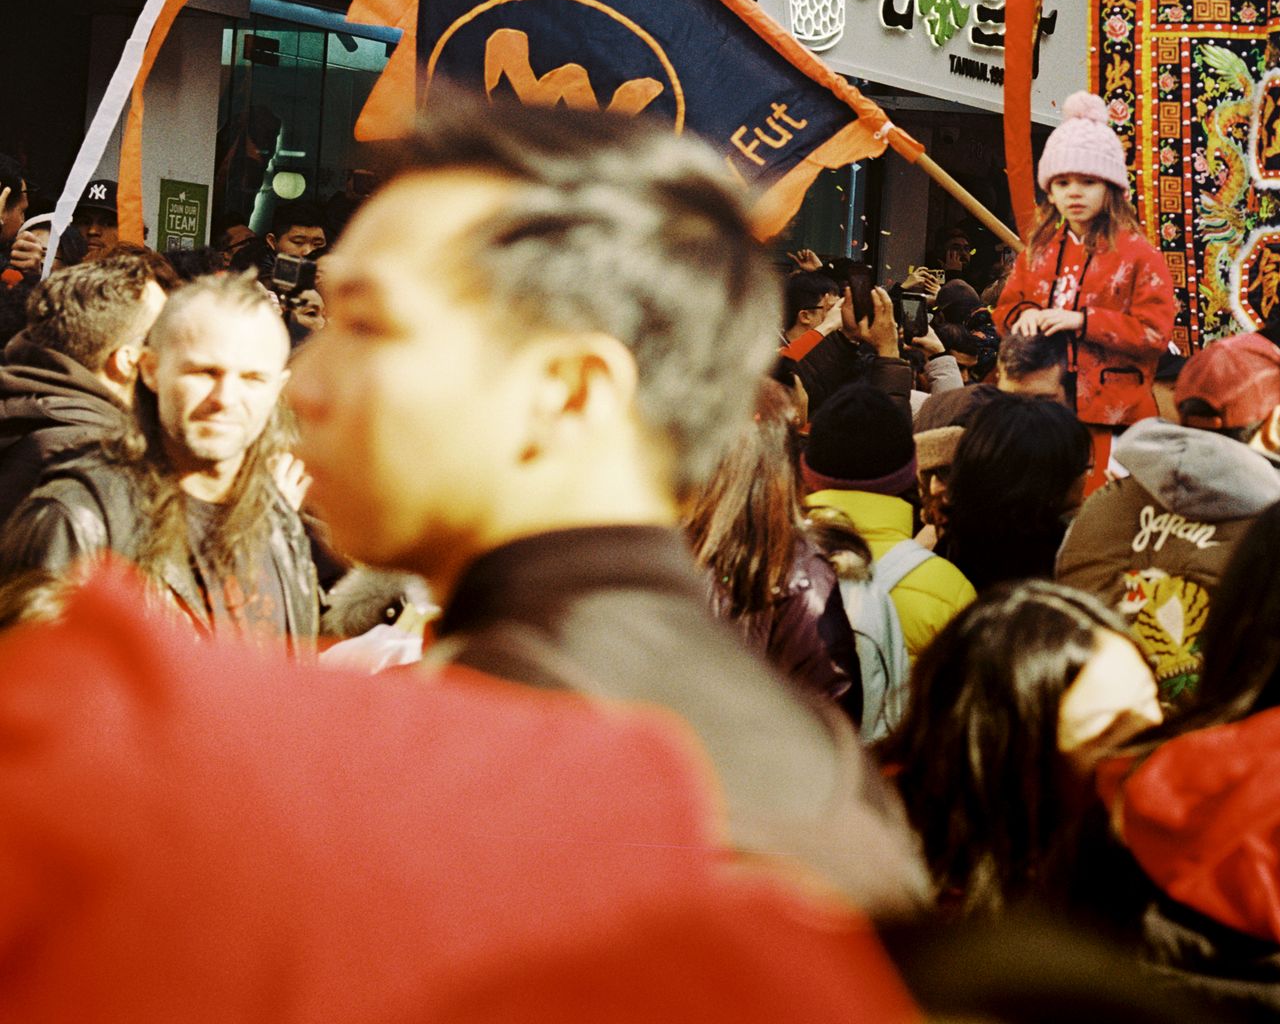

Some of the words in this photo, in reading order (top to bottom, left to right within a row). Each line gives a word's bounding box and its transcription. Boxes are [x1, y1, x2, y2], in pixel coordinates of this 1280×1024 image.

[730, 102, 808, 166] Fut
[89, 184, 107, 200] NY
[169, 215, 196, 231] TEAM
[1132, 505, 1222, 552] Japan
